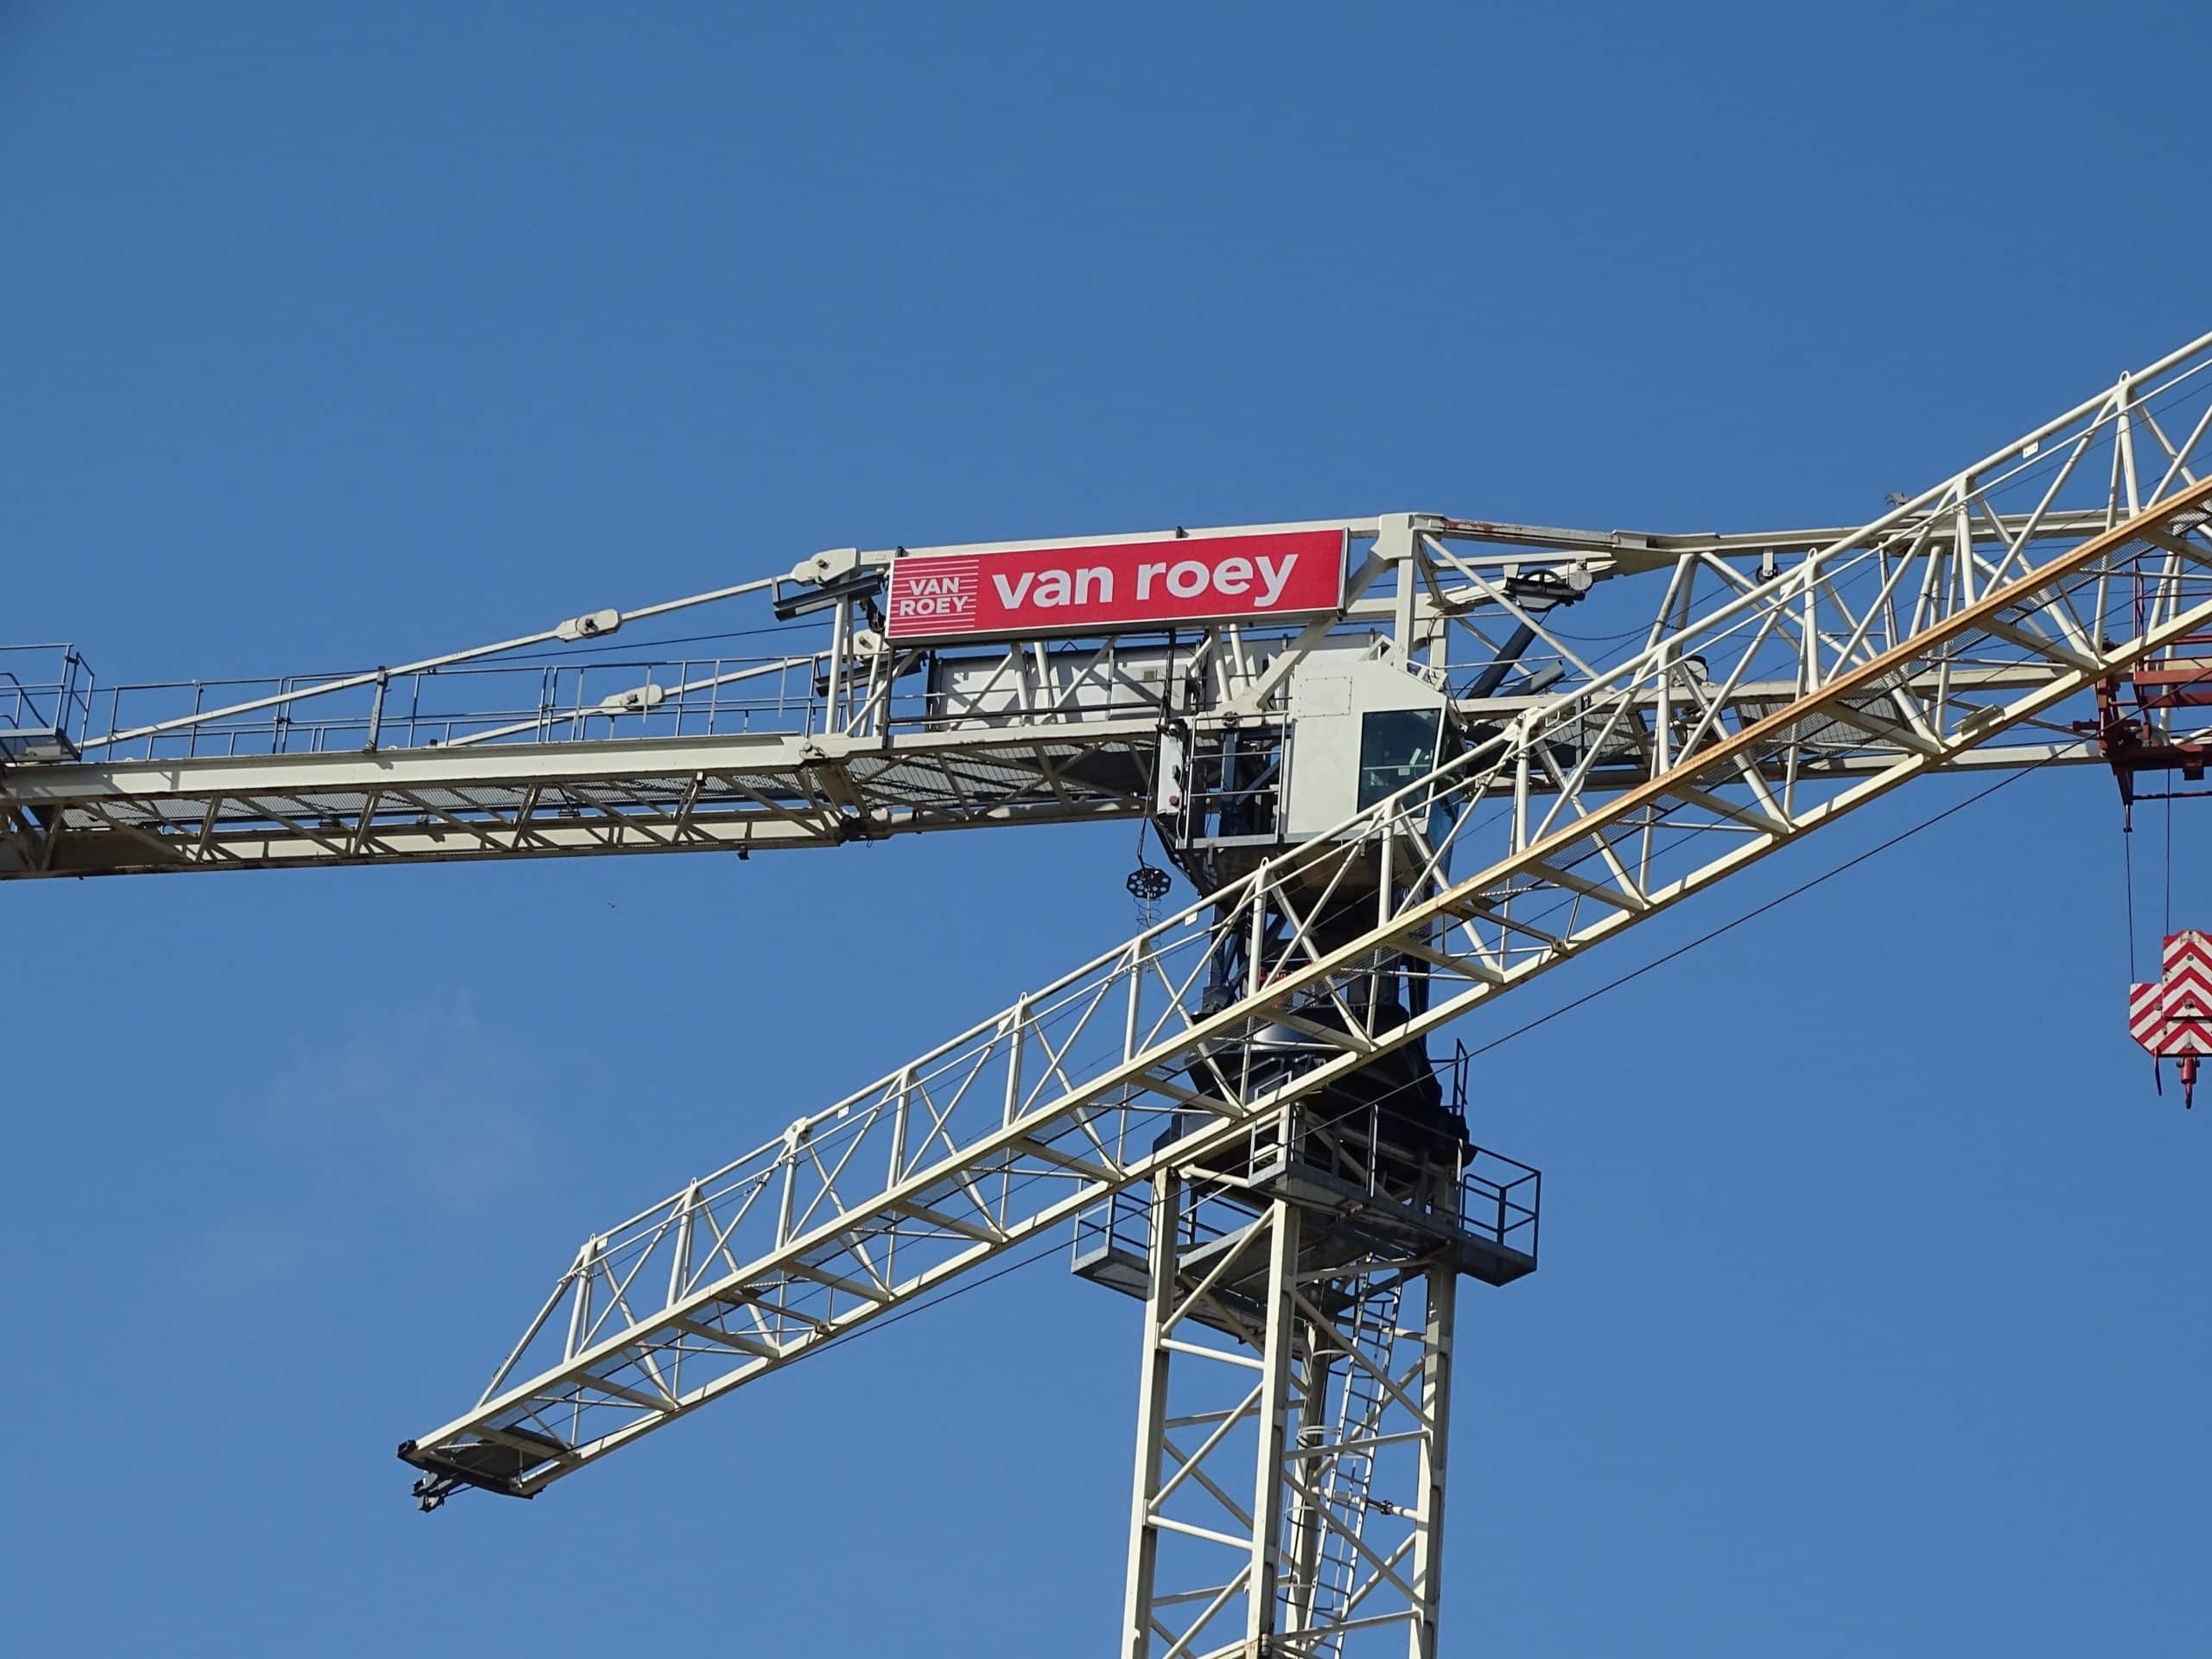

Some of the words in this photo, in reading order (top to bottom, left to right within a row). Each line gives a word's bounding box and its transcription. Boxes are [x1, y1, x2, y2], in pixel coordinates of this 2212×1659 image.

[909, 576, 960, 596] VAN
[992, 566, 1114, 610] van
[1136, 553, 1299, 607] roey
[899, 596, 969, 616] ROEY
